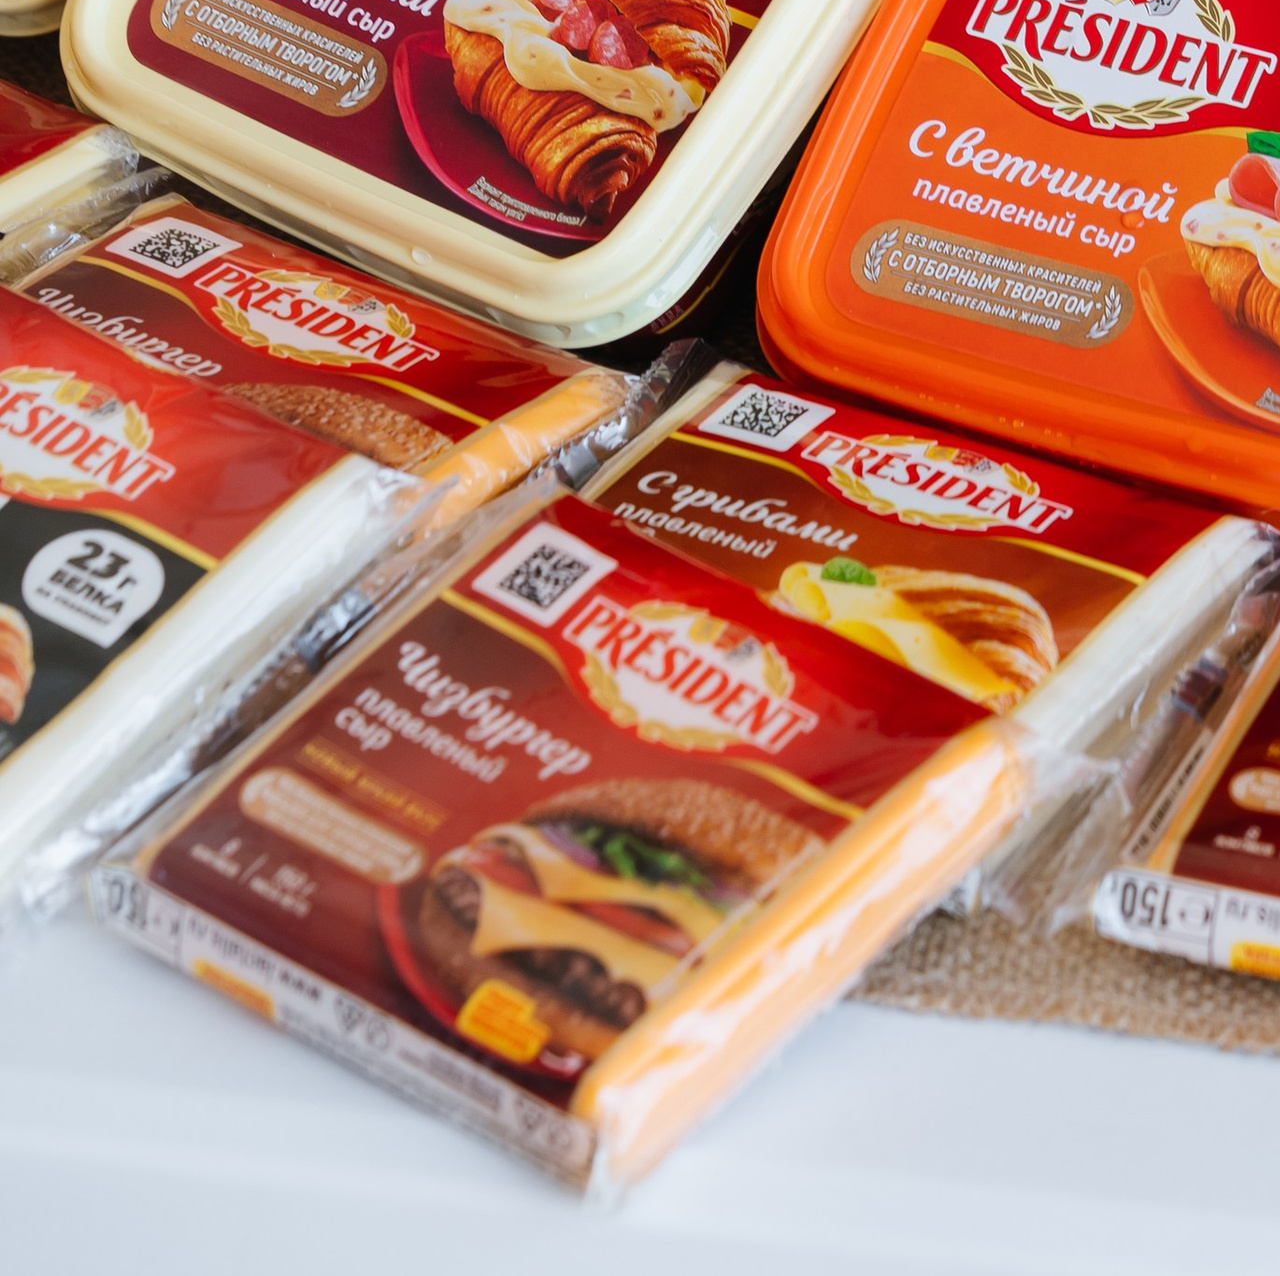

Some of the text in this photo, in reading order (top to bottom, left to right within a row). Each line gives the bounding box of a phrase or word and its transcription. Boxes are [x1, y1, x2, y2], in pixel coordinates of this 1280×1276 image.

[183, 0, 200, 18] С
[196, 6, 280, 53] ОТБОРНЫМ
[301, 27, 364, 64] КРАСИТЕЛЕЙ
[347, 6, 396, 43] сыр
[191, 32, 319, 96] БЕЗ РАСТИТЕЛЬНЫХ ЖИРОВ
[908, 119, 1178, 223] С ветчиной
[912, 178, 1136, 258] плавленый сыр
[887, 250, 903, 268] С
[903, 254, 1001, 293] ОТБОРНЫМ
[904, 232, 1102, 294] БЕЗ ИСКУССТВЕННЫХ КРАСИТЕЛЕЙ
[202, 265, 437, 370] PRÉSIDENT
[904, 280, 1061, 331] БЕЗ РАСТИТЕЛЬНЫХ ЖИРОВ
[0, 382, 169, 494] ÉSIDENT
[637, 470, 859, 552] С грибами
[809, 435, 1070, 530] PRÉSIDENT
[67, 539, 129, 579] 23
[613, 501, 778, 559] плавленый
[49, 569, 125, 616] БЕЛКА
[571, 602, 808, 751] PRÉSIDENT
[334, 706, 393, 751] сыр
[354, 686, 508, 783] плавленый
[397, 640, 590, 781] Чизбургер
[1121, 881, 1171, 928] 150
